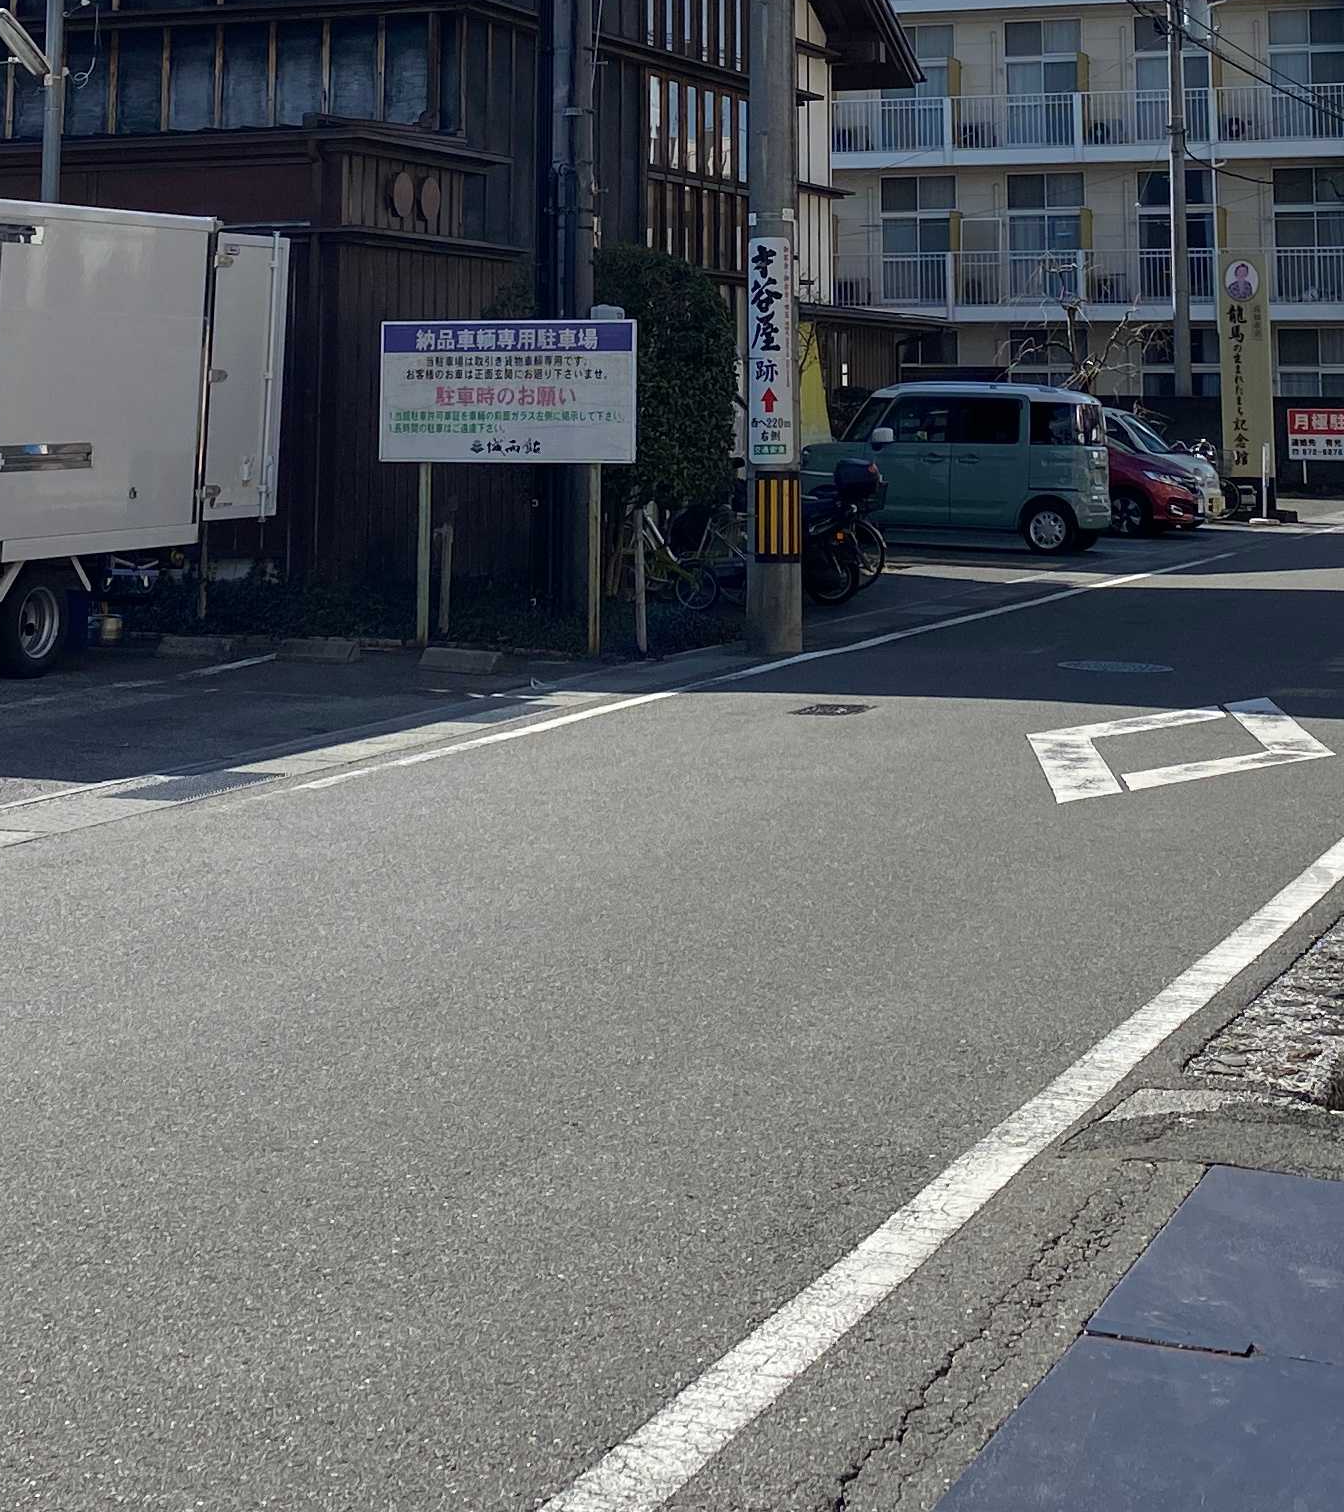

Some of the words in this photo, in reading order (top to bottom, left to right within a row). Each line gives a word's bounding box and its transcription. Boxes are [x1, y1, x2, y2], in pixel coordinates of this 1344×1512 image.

[435, 385, 577, 407] 駐車時のお願い
